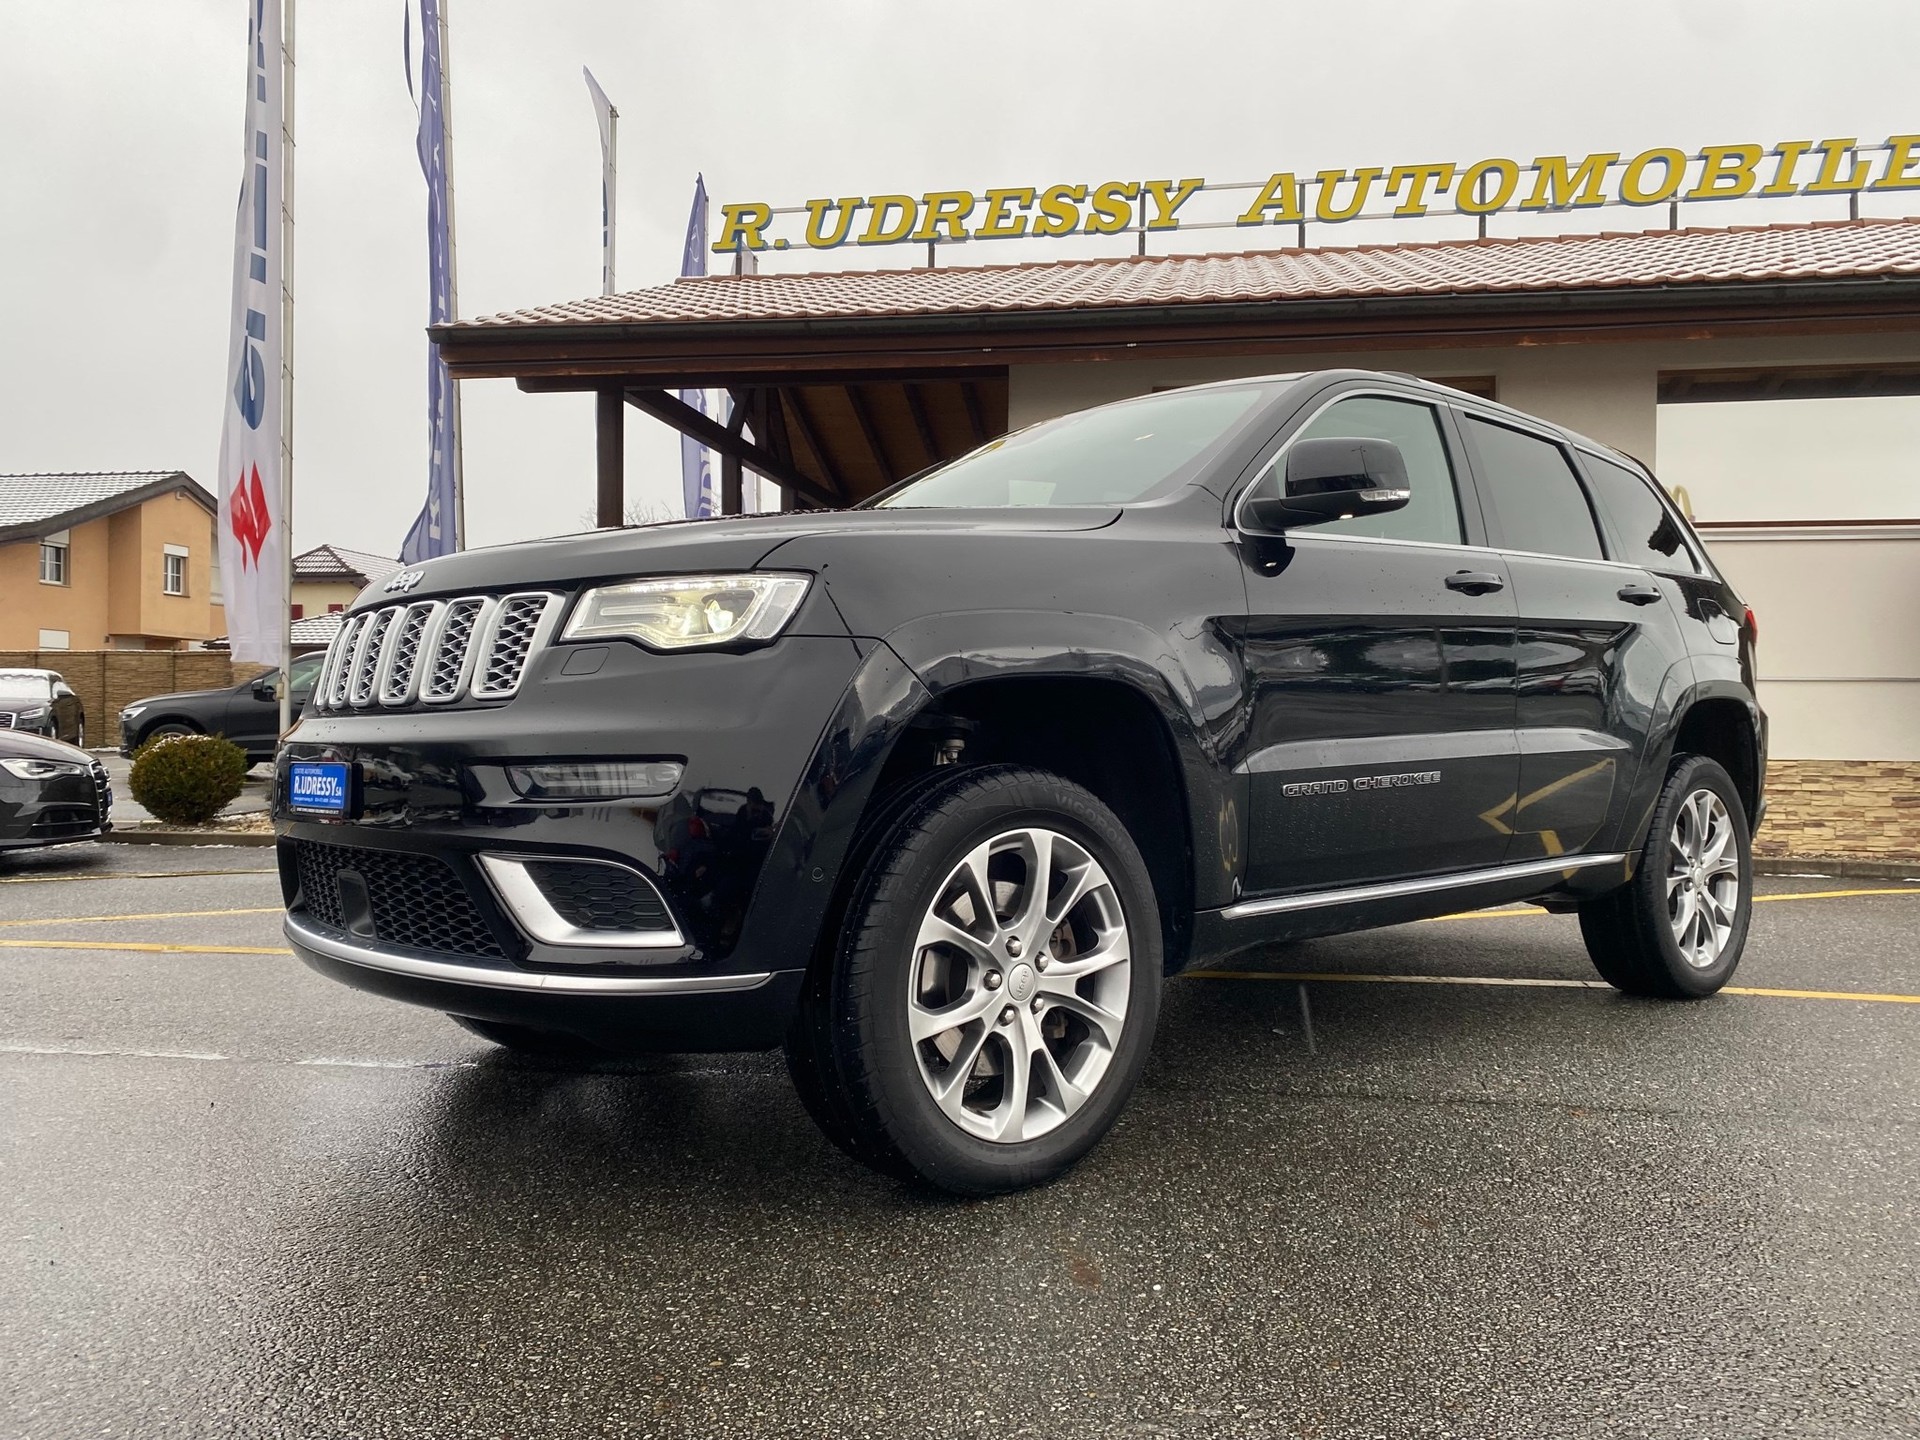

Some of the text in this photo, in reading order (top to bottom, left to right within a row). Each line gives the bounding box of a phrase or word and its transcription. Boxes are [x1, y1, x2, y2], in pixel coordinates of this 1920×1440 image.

[1237, 134, 1920, 227] AUTOMOBILE
[384, 570, 425, 593] Jeep
[294, 776, 337, 796] R.UDRESSY
[1282, 771, 1441, 797] GRAND CHEROKEE
